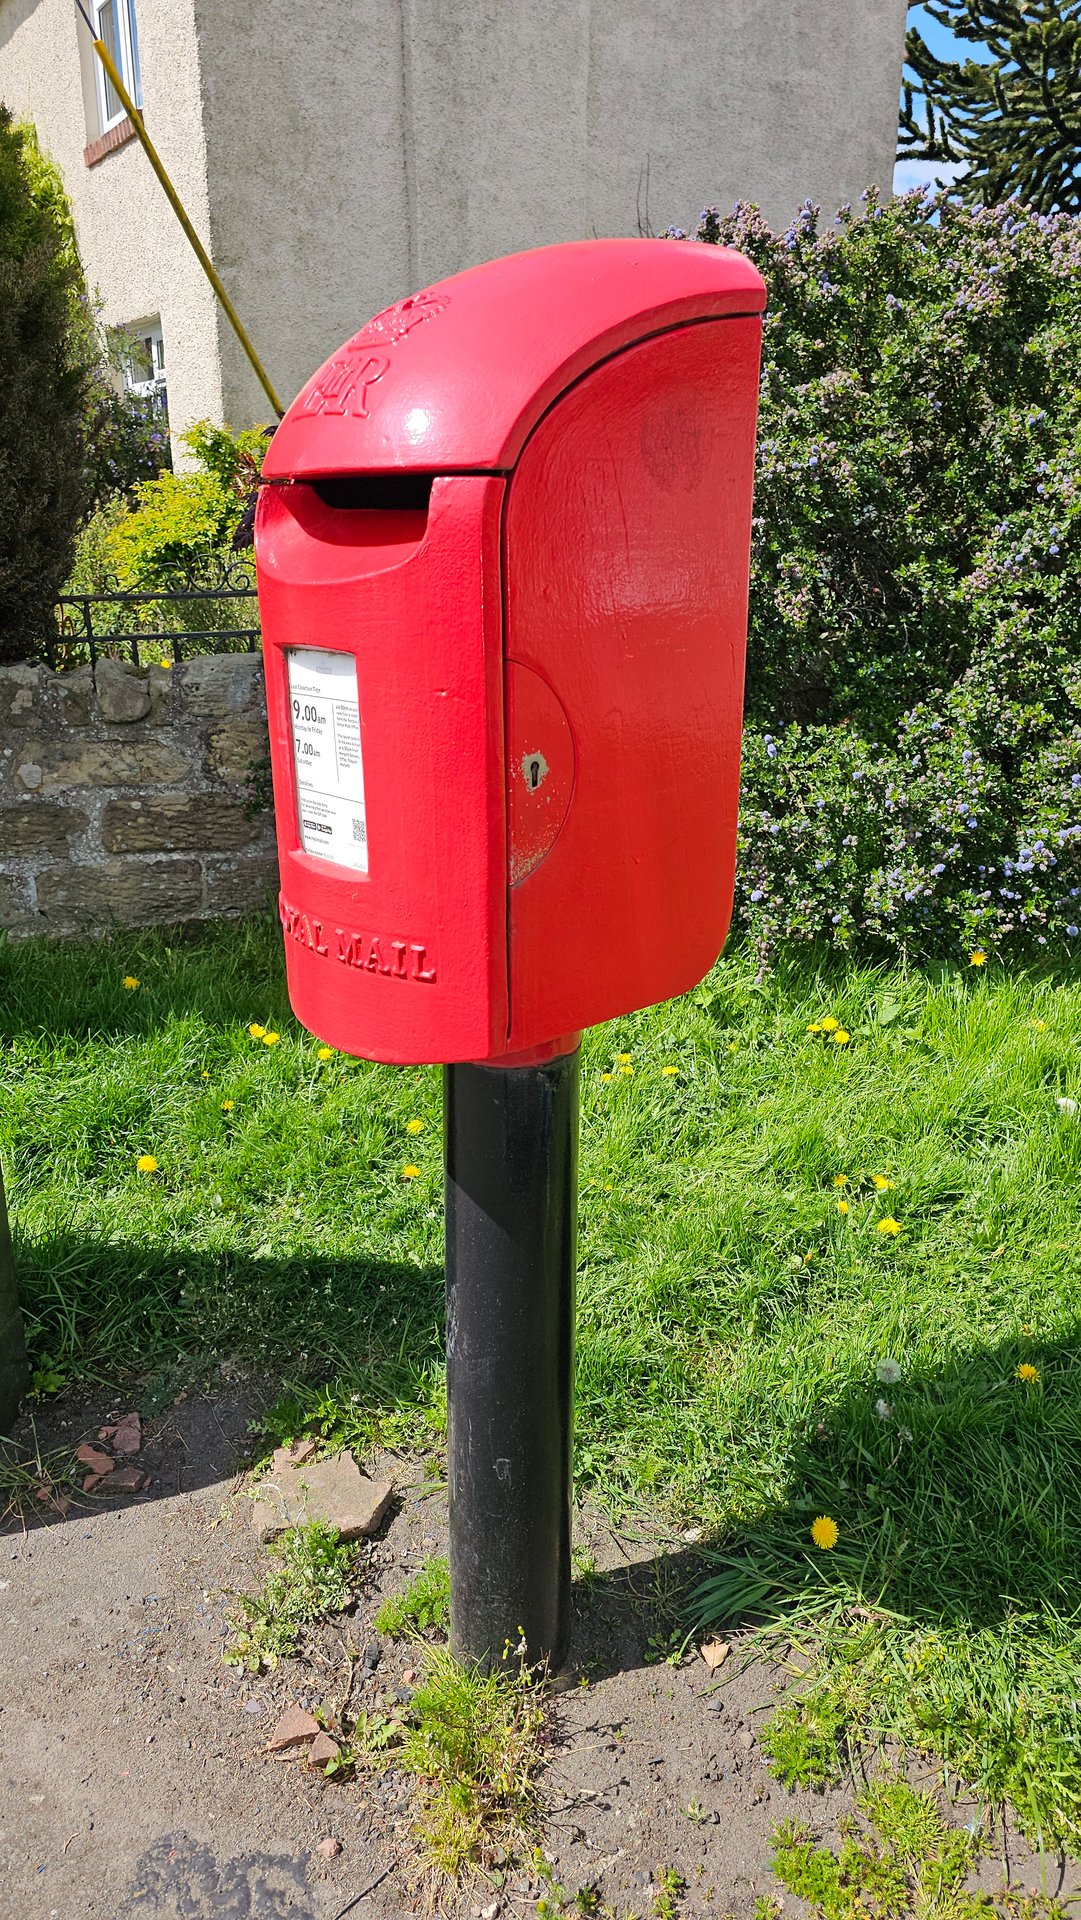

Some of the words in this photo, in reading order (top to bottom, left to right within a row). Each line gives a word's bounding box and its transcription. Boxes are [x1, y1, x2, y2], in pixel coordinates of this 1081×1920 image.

[294, 723, 307, 732] Monday
[312, 727, 322, 735] Friday
[282, 905, 328, 958] YAL
[334, 927, 437, 984] MAIL
